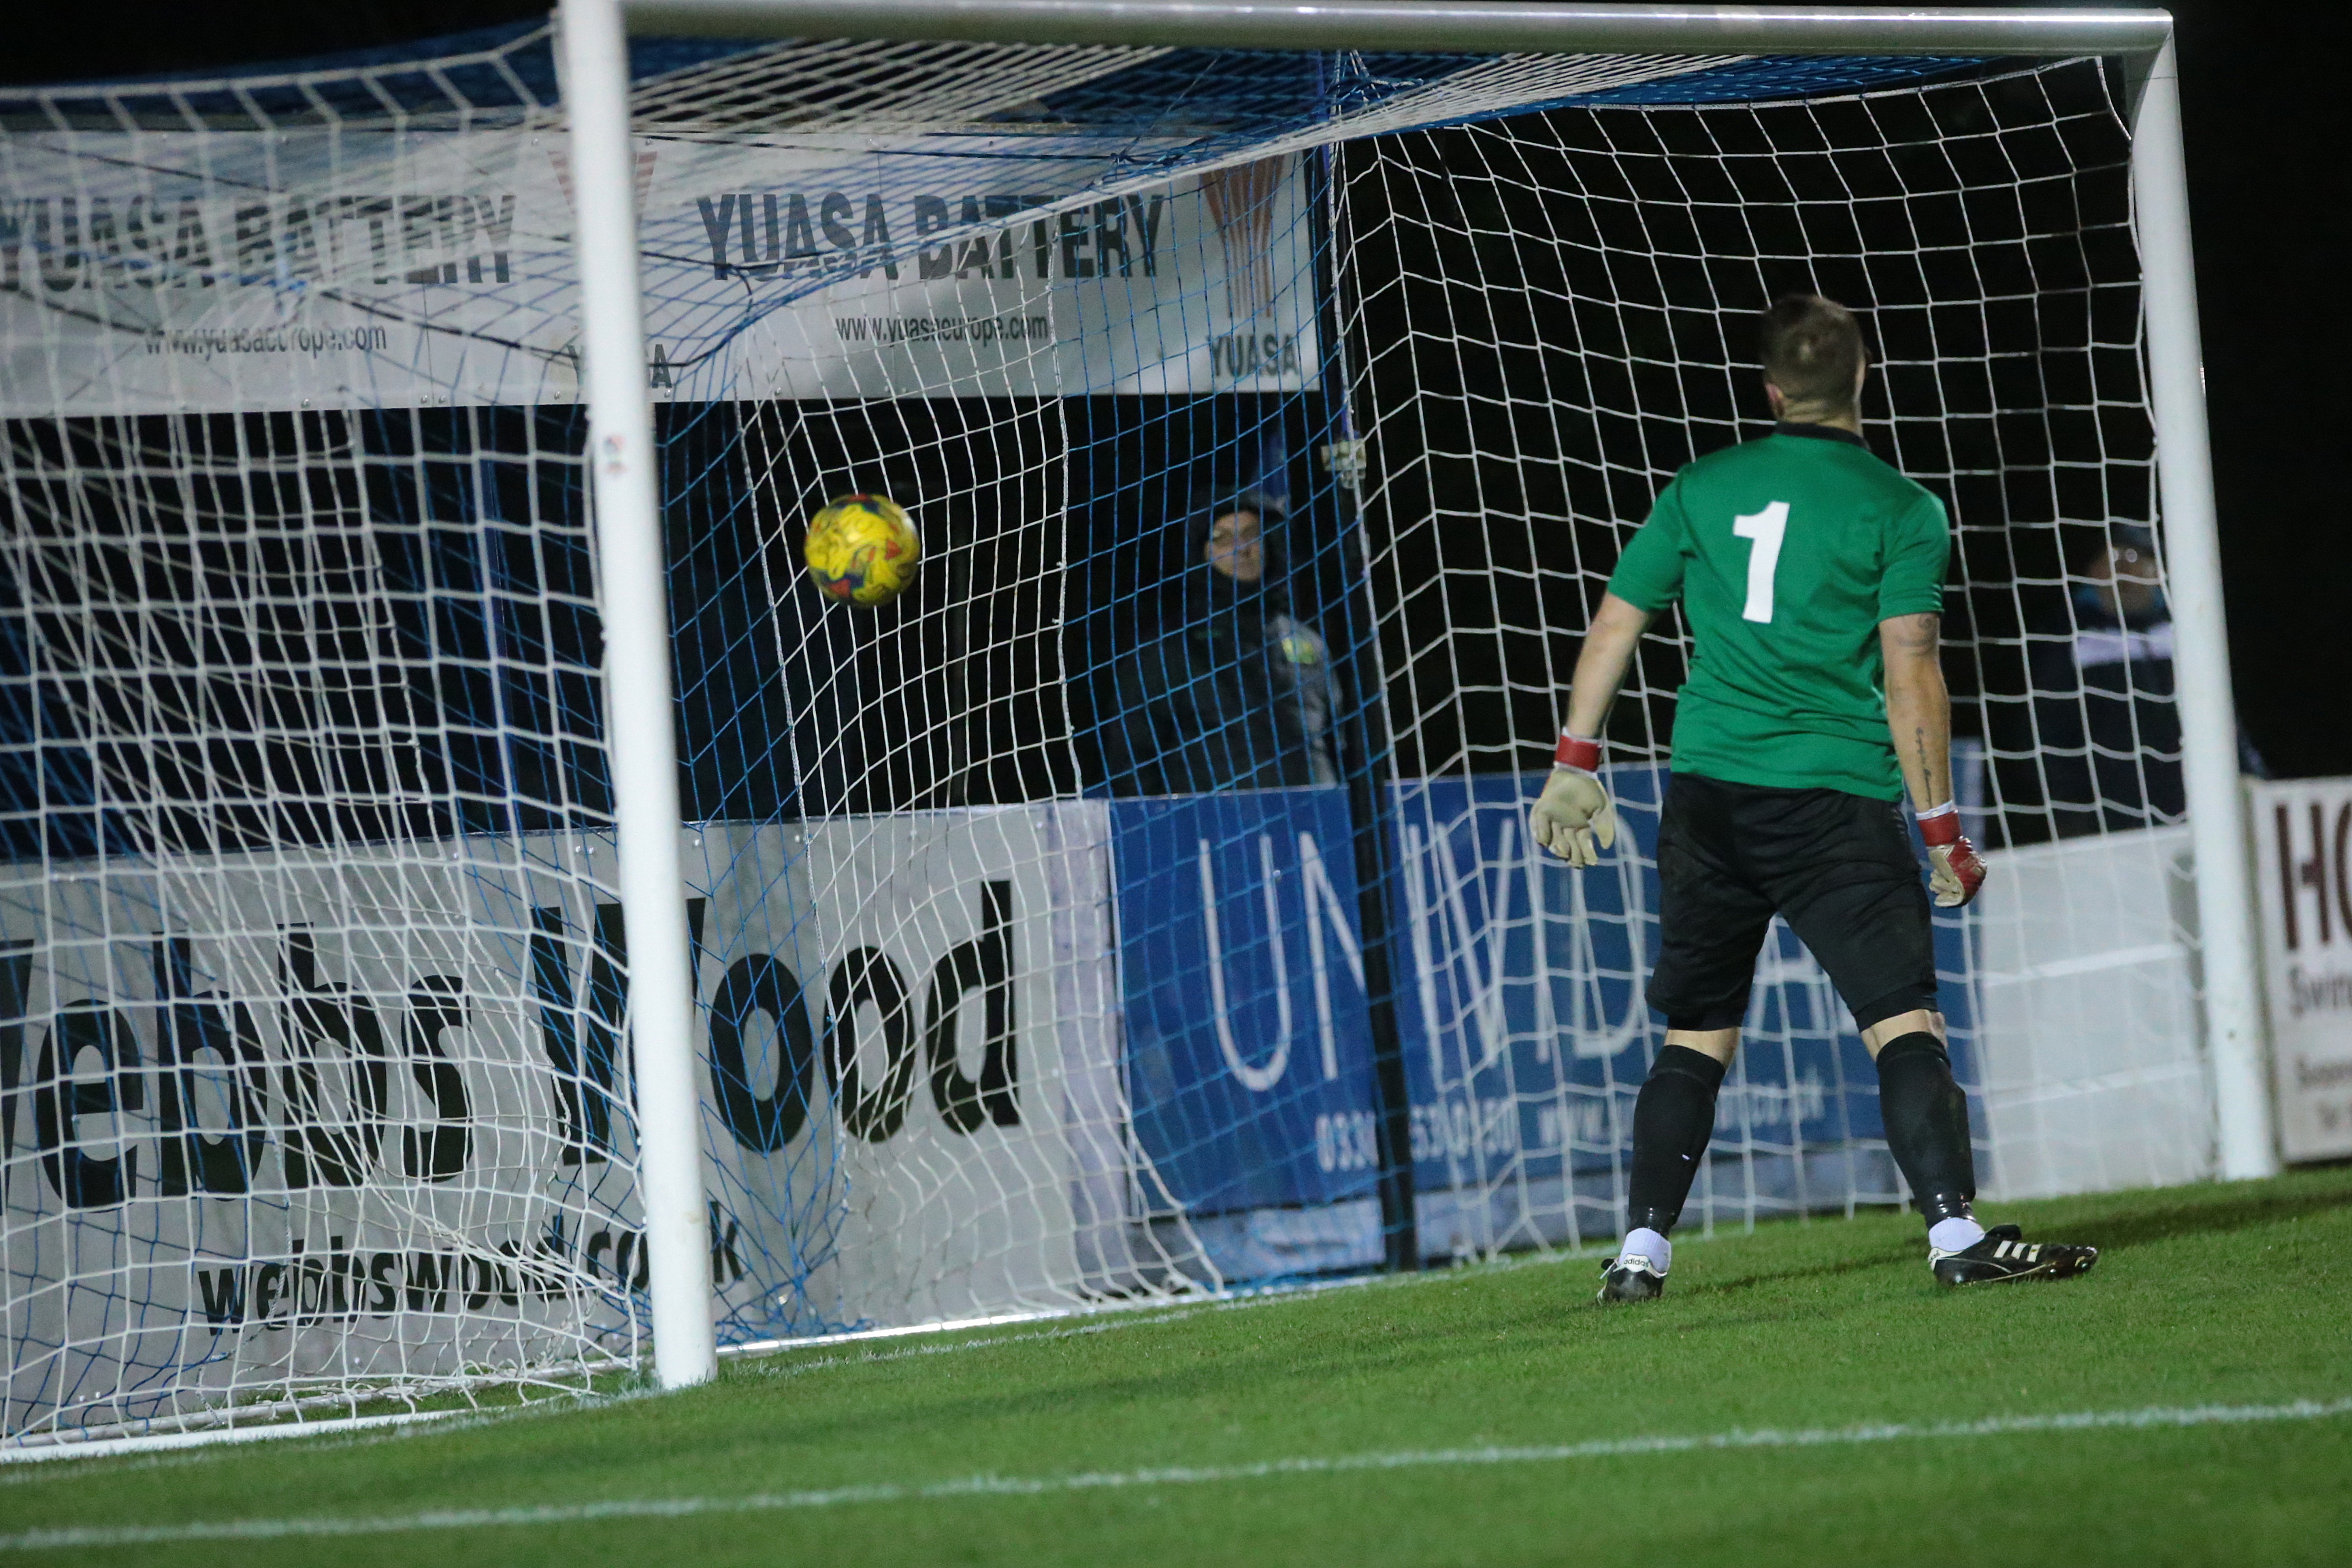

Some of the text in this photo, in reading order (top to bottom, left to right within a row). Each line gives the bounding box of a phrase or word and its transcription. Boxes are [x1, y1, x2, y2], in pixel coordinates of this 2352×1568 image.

[696, 189, 1165, 281] YUASA BATTERY
[835, 315, 1049, 348] www.yuasaeurope.com
[1207, 333, 1301, 376] YUASA
[1733, 501, 1791, 624] 1
[0, 880, 1020, 1215] ebbs Wood
[1623, 1257, 1650, 1268] adidas
